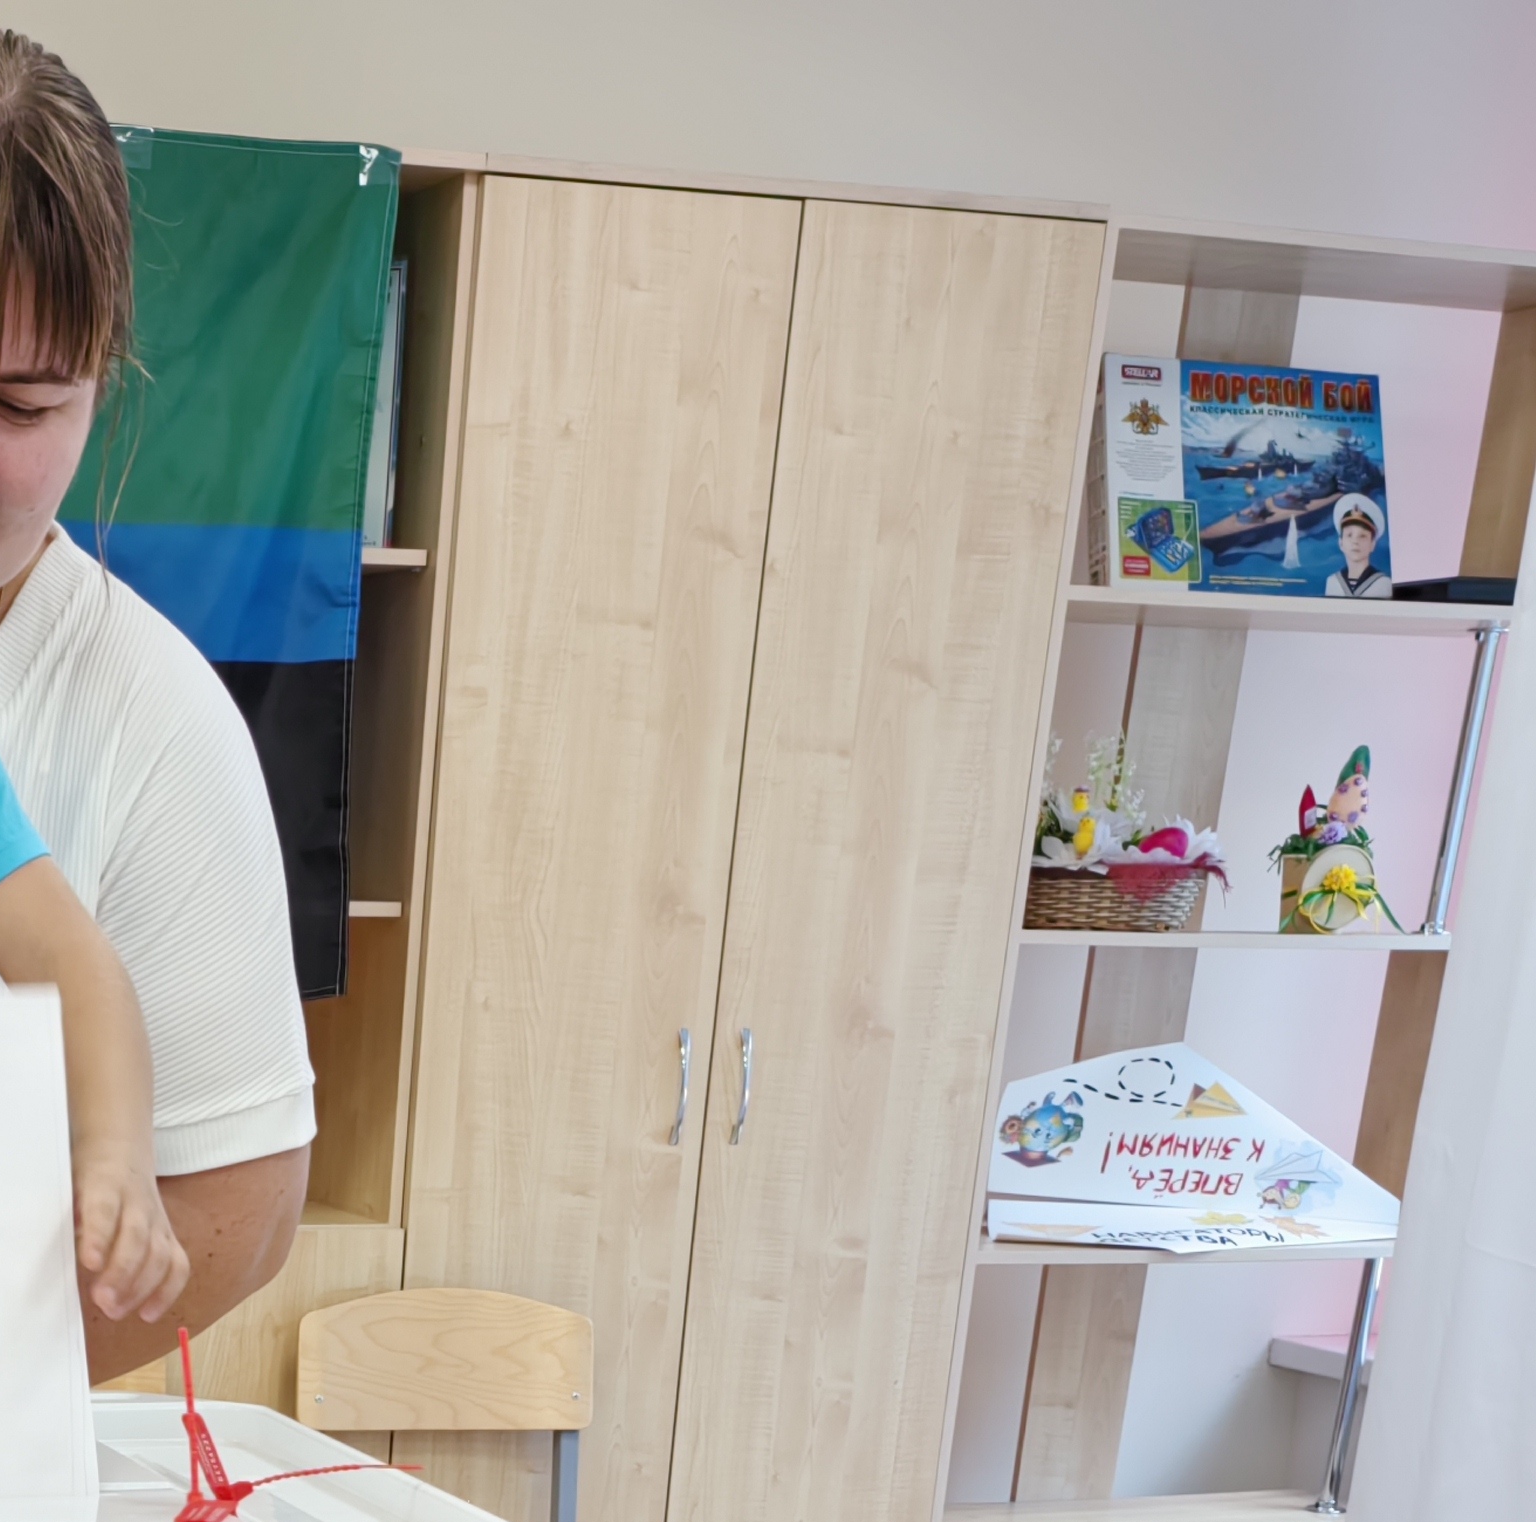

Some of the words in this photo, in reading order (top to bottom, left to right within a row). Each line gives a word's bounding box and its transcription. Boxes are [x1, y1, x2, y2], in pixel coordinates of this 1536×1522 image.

[1189, 370, 1313, 410] МОРСКОЙ
[1322, 379, 1374, 414] БОЙ
[1190, 405, 1264, 416] КЛАССИЧЕСКАЯ
[1100, 1131, 1242, 1174] ЗНАНИЯМ!
[1246, 1137, 1266, 1162] К
[1128, 1164, 1244, 1198] ВПЕРЁД,
